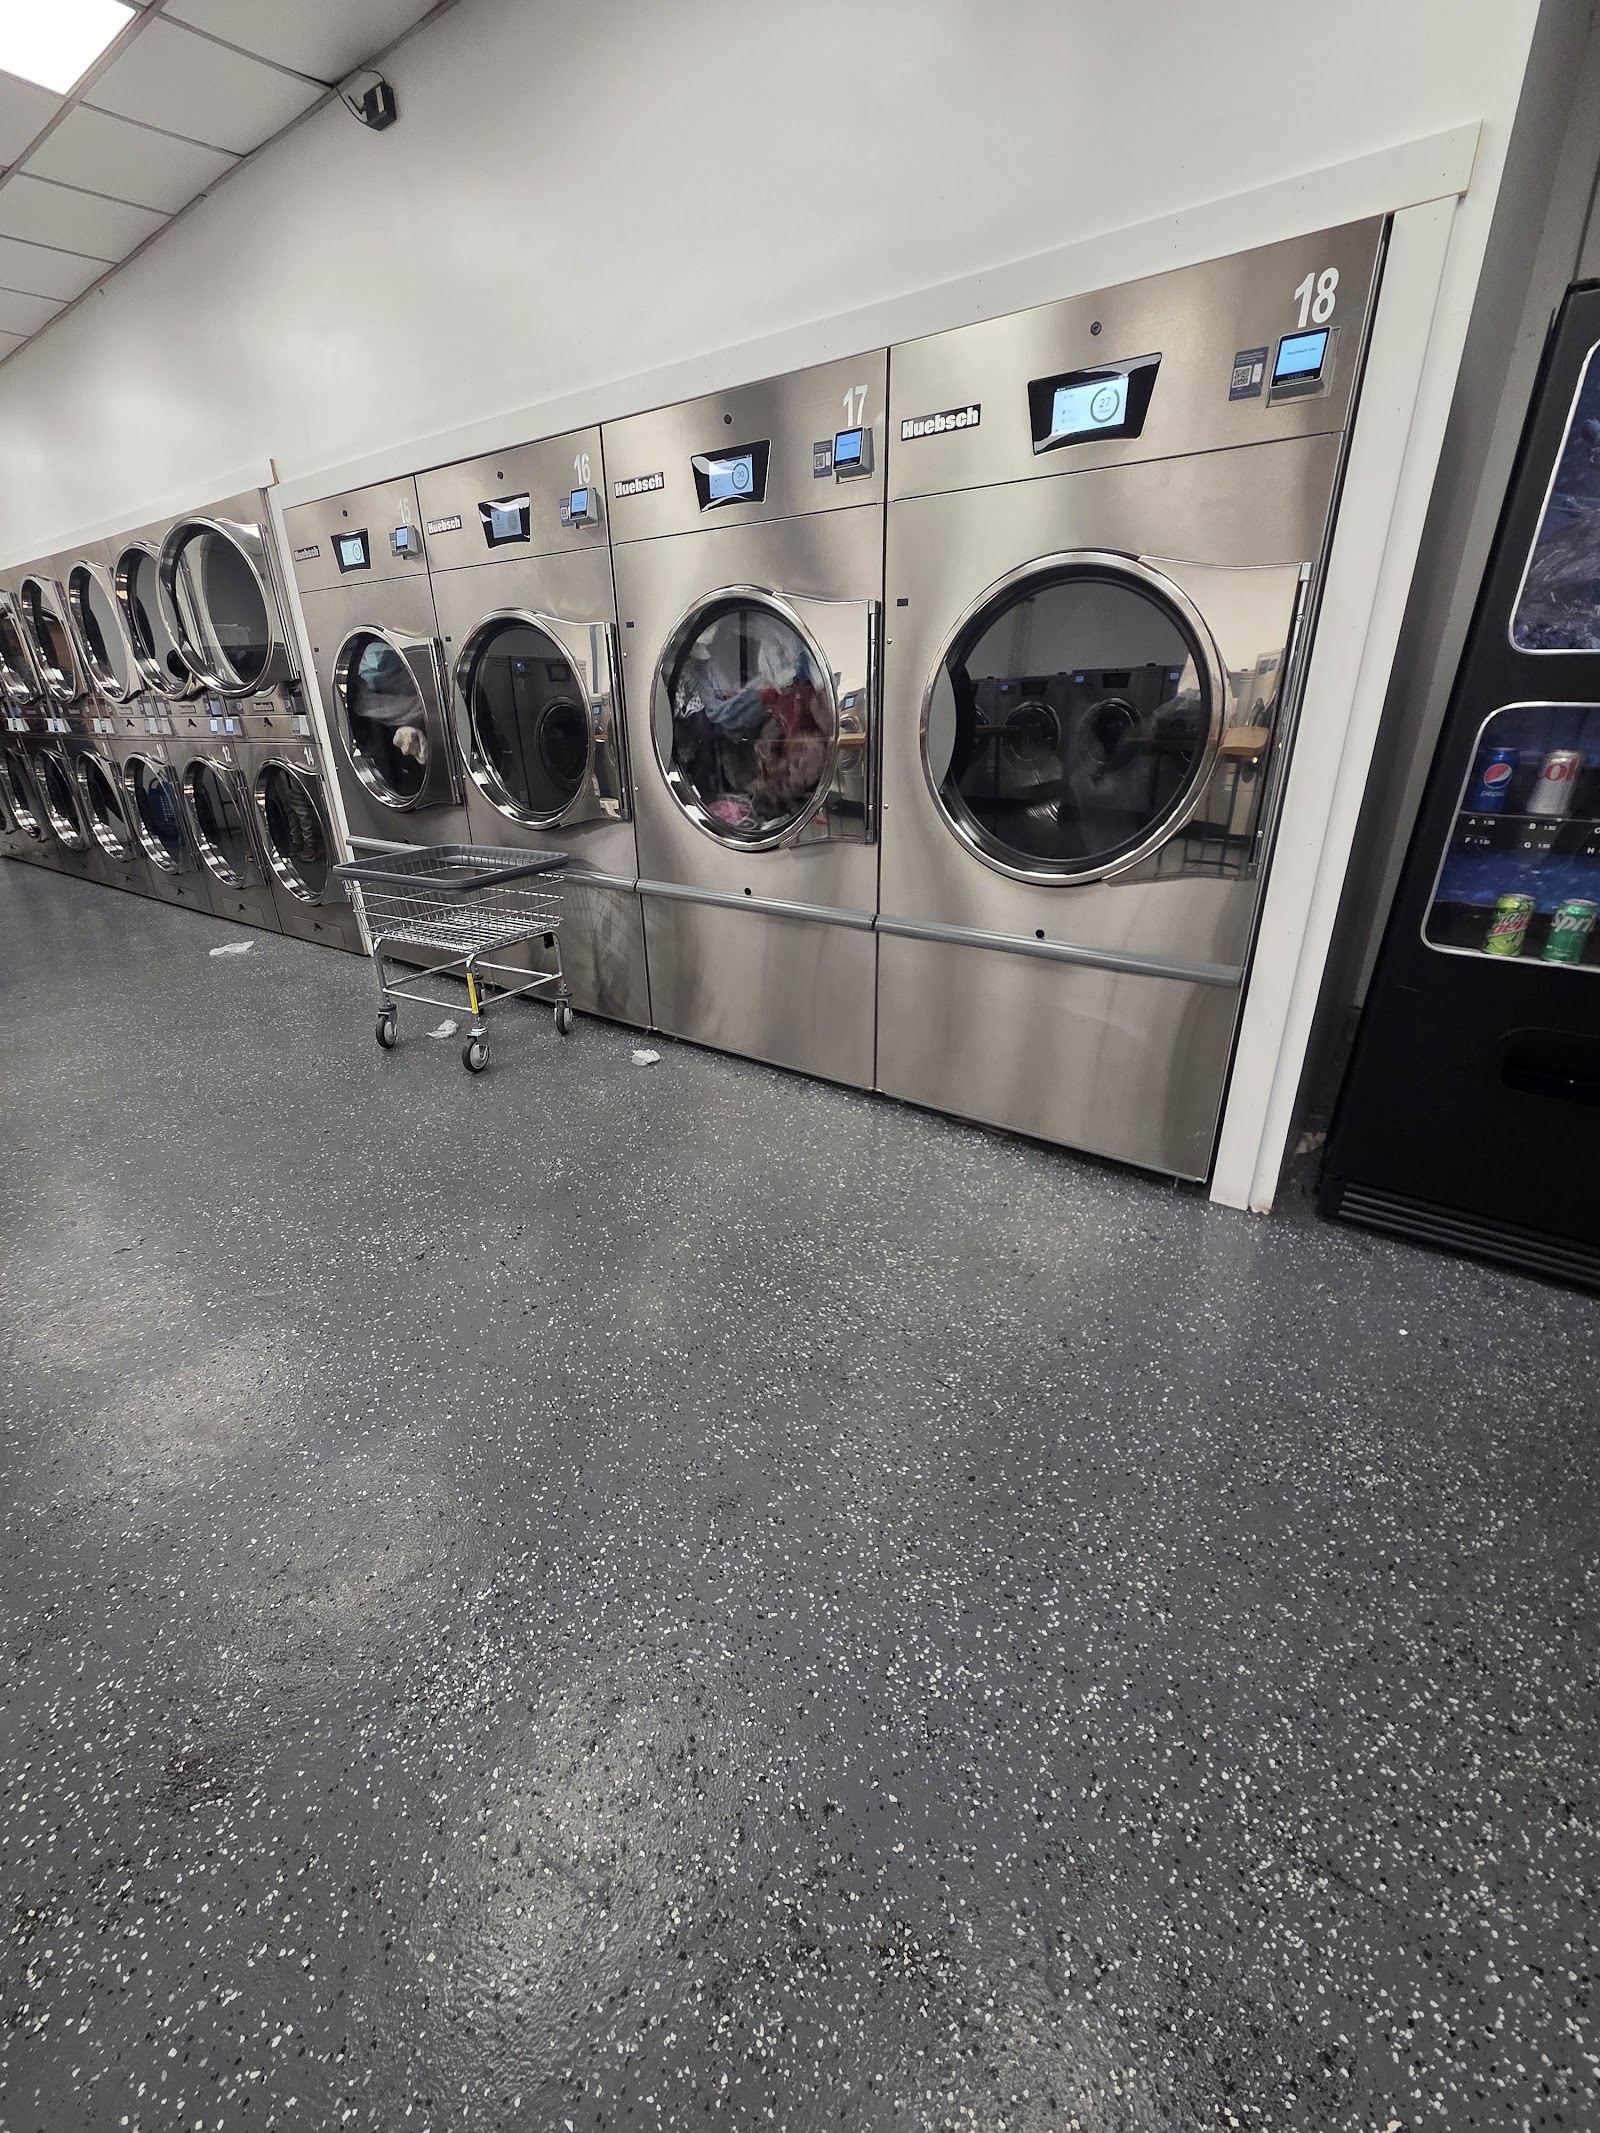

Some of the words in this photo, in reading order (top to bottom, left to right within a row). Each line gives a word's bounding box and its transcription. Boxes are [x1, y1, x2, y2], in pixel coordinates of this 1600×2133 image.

[1293, 267, 1340, 329] 18
[842, 384, 868, 428] 17
[1099, 396, 1112, 408] 27
[902, 406, 979, 439] Huebsch
[573, 452, 591, 486] 16
[736, 470, 746, 479] 30
[614, 474, 663, 497] Huebsch
[400, 497, 411, 524] 15
[427, 516, 462, 535] Huebsch
[221, 745, 233, 763] 12
[303, 746, 315, 766] 14
[1480, 789, 1505, 798] pepsi
[1468, 818, 1476, 826] A
[1528, 822, 1537, 830] B
[1464, 836, 1472, 844] F
[1586, 846, 1596, 854] H
[1550, 909, 1598, 933] Spri
